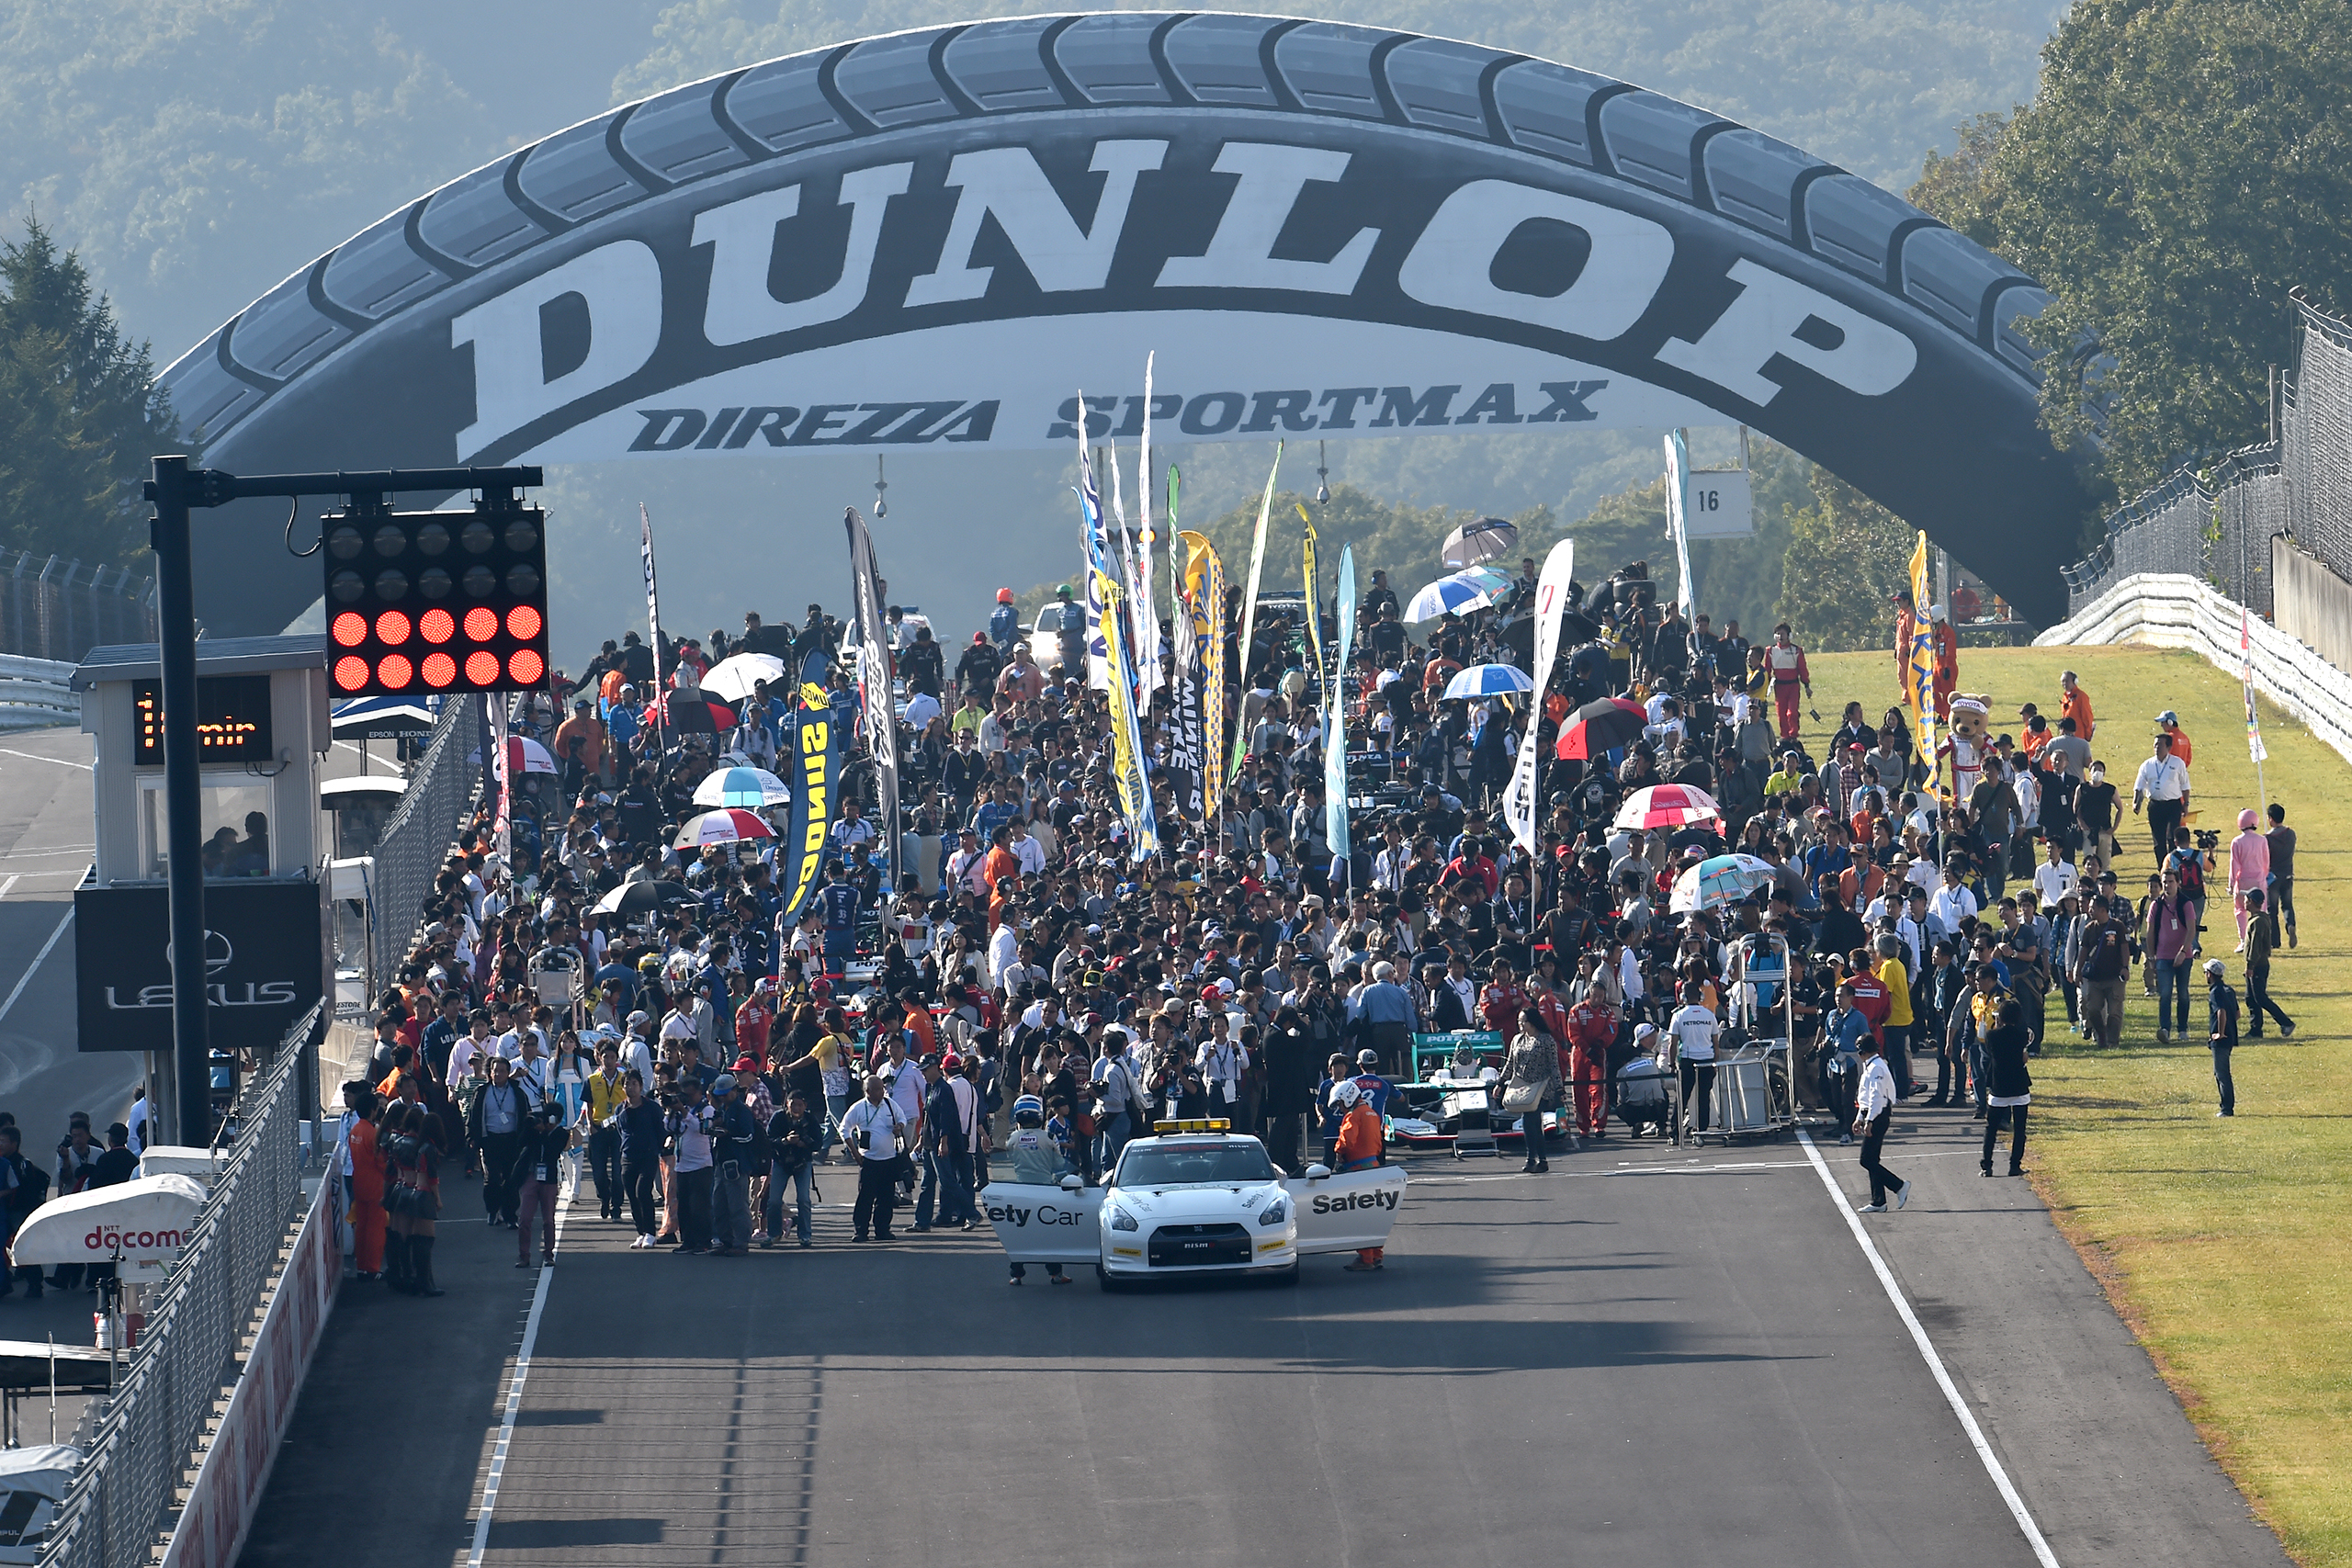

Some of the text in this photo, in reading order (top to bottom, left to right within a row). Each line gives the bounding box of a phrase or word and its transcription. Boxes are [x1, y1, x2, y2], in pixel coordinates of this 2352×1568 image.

[451, 140, 1918, 463] DUNLOP
[628, 378, 1610, 452] DIREZZA SPORTMAX
[1699, 490, 1719, 512] 16
[1957, 701, 1981, 709] TOYOTA
[368, 730, 395, 739] EPSON
[1312, 1188, 1399, 1214] Safety
[983, 1203, 1083, 1227] ety Car
